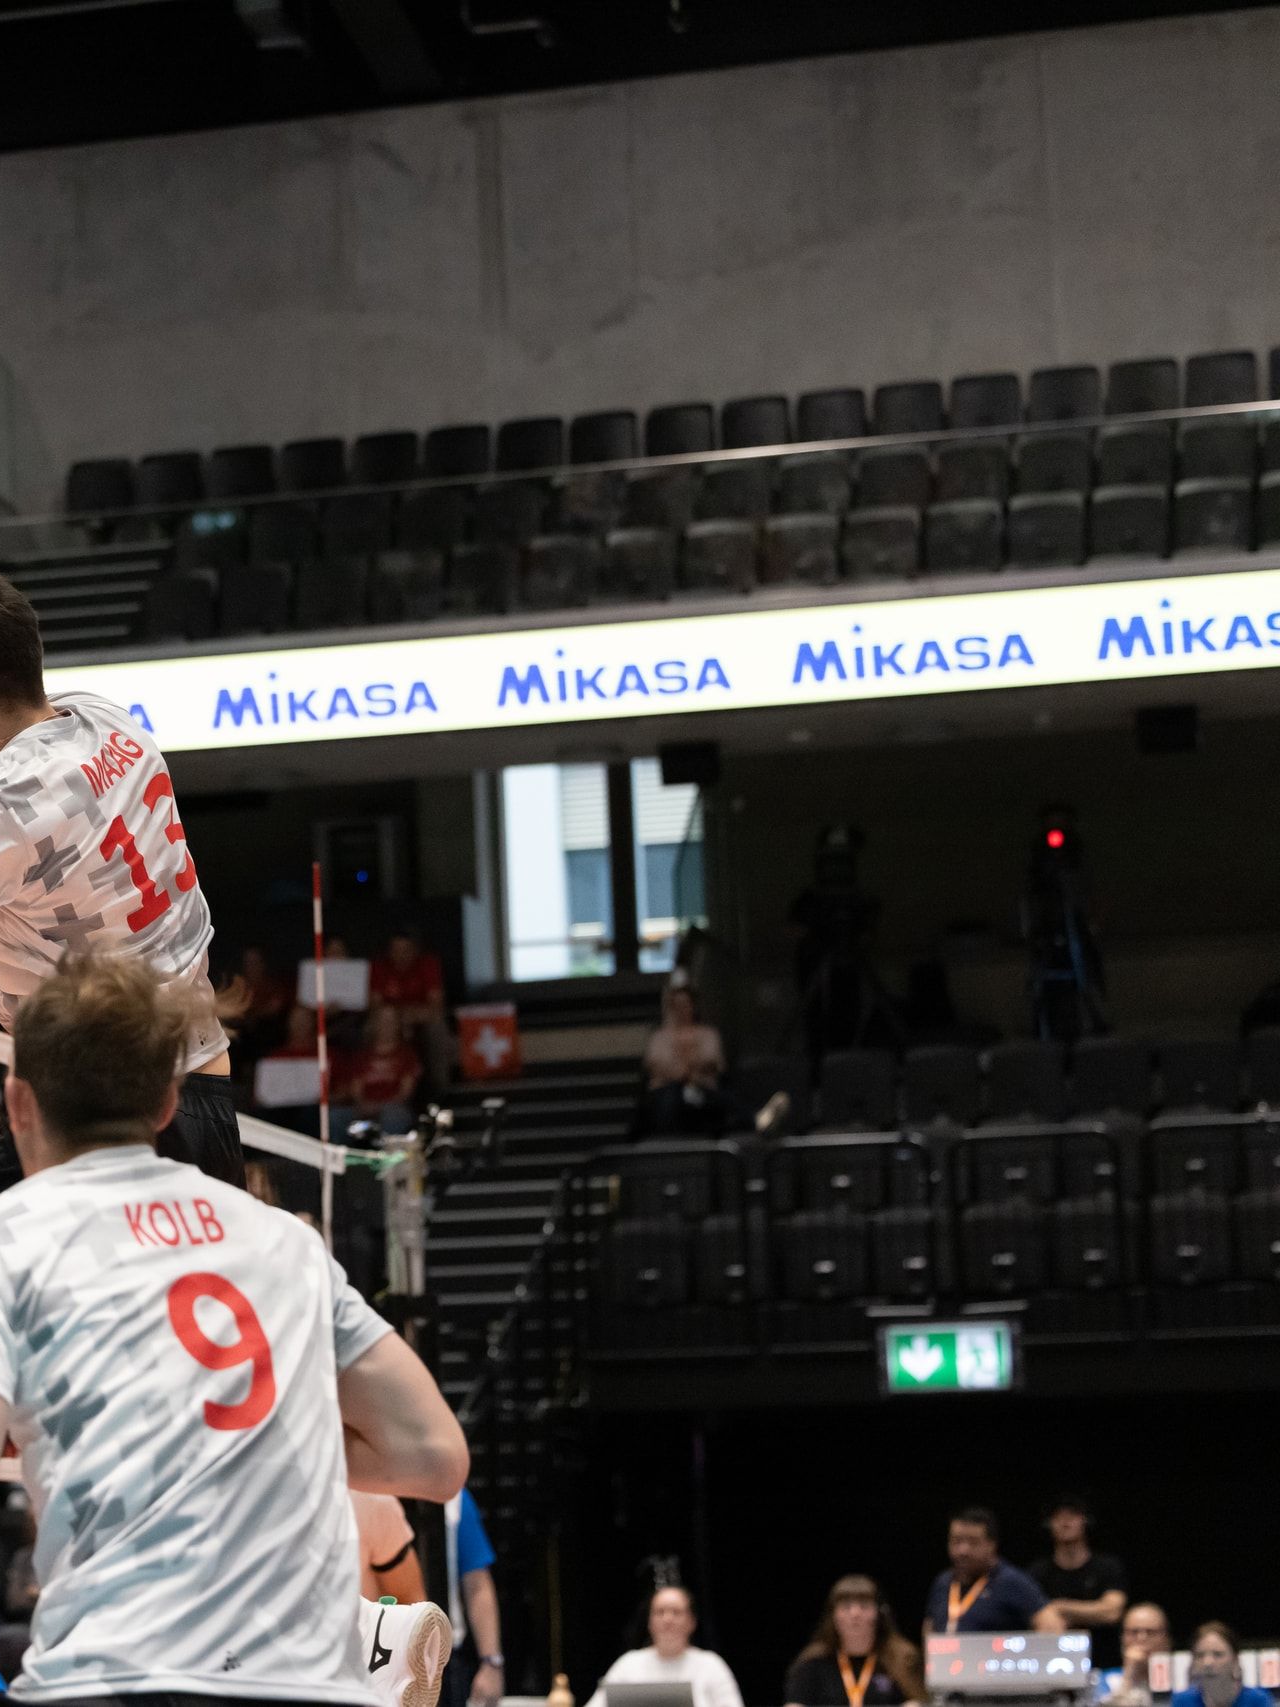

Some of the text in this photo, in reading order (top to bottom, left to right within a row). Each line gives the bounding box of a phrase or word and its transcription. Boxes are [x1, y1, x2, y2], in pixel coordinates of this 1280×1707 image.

[80, 732, 144, 798] MAAG
[123, 1198, 225, 1247] KOLB
[167, 1271, 276, 1431] 9
